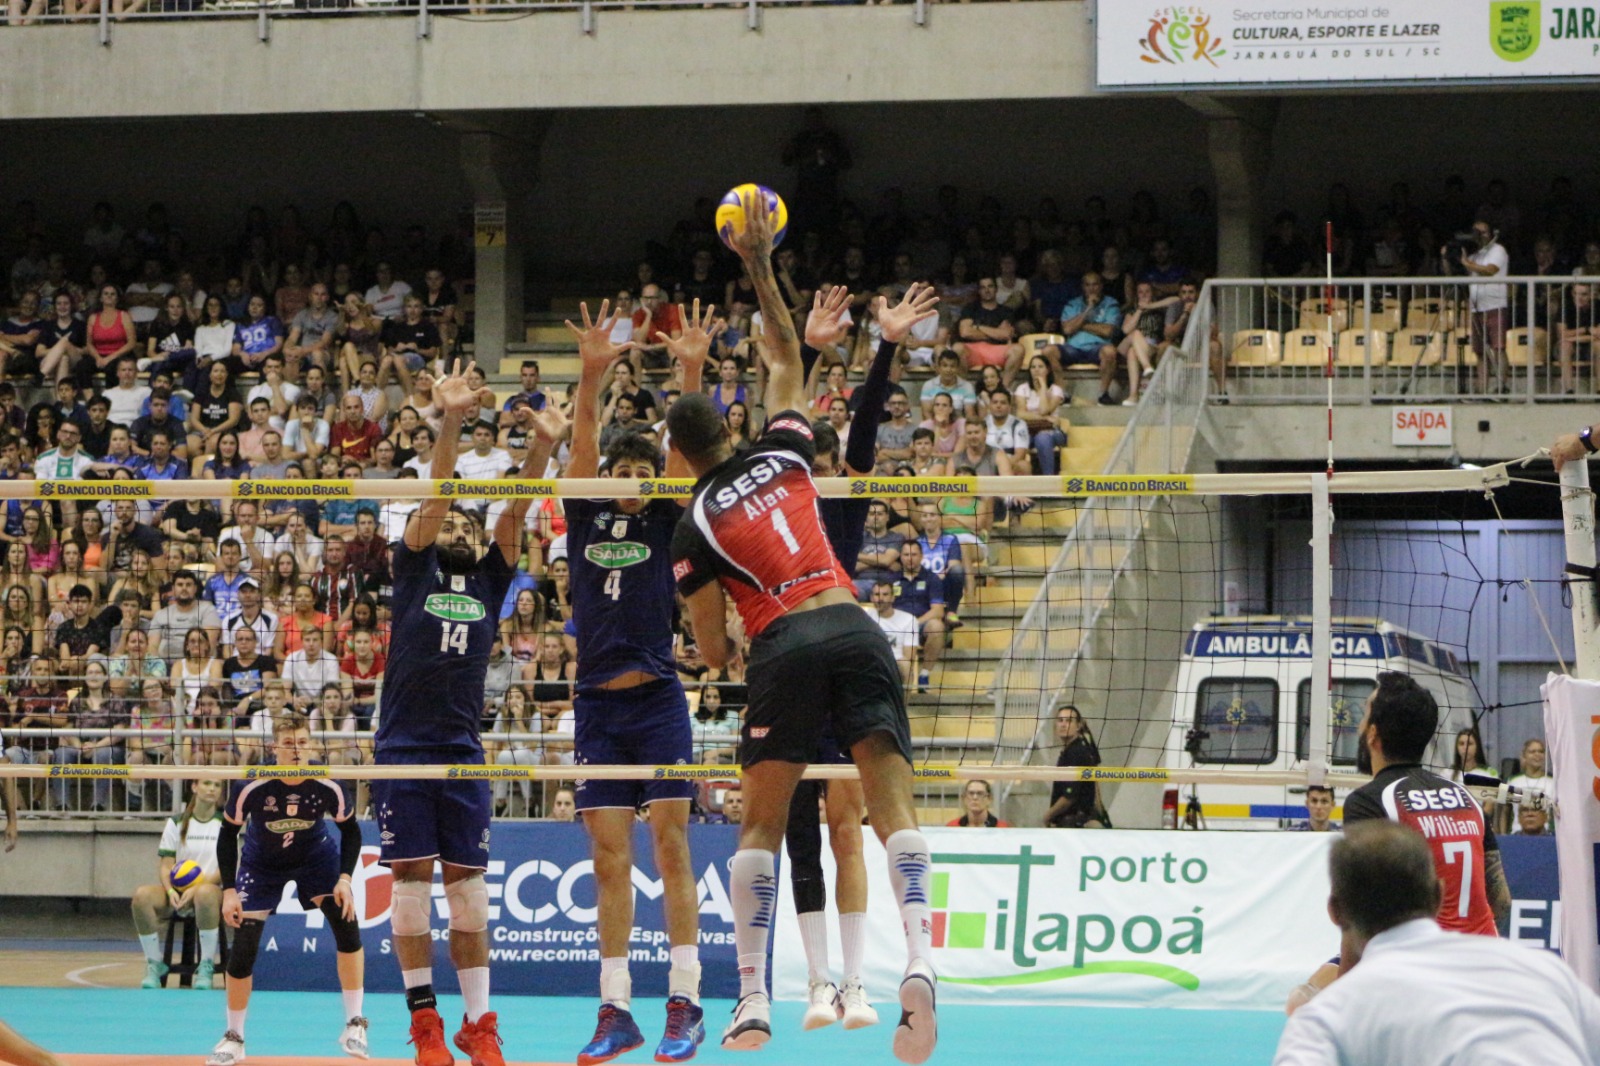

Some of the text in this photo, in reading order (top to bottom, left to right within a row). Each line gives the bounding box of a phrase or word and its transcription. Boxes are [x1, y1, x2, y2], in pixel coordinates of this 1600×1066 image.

[1233, 7, 1389, 21] Secretaria Municipal de
[1233, 24, 1440, 40] CULTURA, ESPORTE E LAZER
[1233, 49, 1317, 60] JARAGUÁ
[1332, 49, 1351, 58] DO
[1365, 49, 1394, 57] SUL
[1423, 47, 1440, 56] SC
[57, 484, 151, 496] BANCO DO BRASIL
[256, 484, 351, 495] BANCO DO BRASIL
[457, 484, 554, 495] BANCO DO BRASIL
[716, 457, 783, 509] SESI
[870, 481, 969, 493] BANCO DO BRASIL
[1086, 480, 1189, 491] BANCO DO BRASIL
[771, 507, 801, 555] 1
[592, 546, 640, 560] SADA
[603, 569, 622, 601] 4
[431, 597, 480, 616] SADA
[440, 620, 469, 655] 14
[1206, 633, 1373, 656] AMBULÂCIA
[63, 767, 89, 775] BANCO
[102, 767, 129, 775] BRASIL
[259, 769, 286, 777] BANCO
[299, 769, 326, 777] BRASIL
[460, 768, 489, 776] BANCO
[502, 768, 529, 776] BRASIL
[667, 769, 696, 777] BANCO
[709, 769, 738, 777] BRASIL
[922, 768, 951, 777] BRASIL
[1095, 770, 1124, 778] BANCO
[1138, 770, 1168, 779] BRASIL
[1408, 787, 1465, 811] SESI
[271, 821, 310, 831] SADA
[1417, 815, 1480, 839] William
[282, 831, 295, 848] 2
[1079, 852, 1208, 892] porto
[1442, 841, 1473, 918] 7
